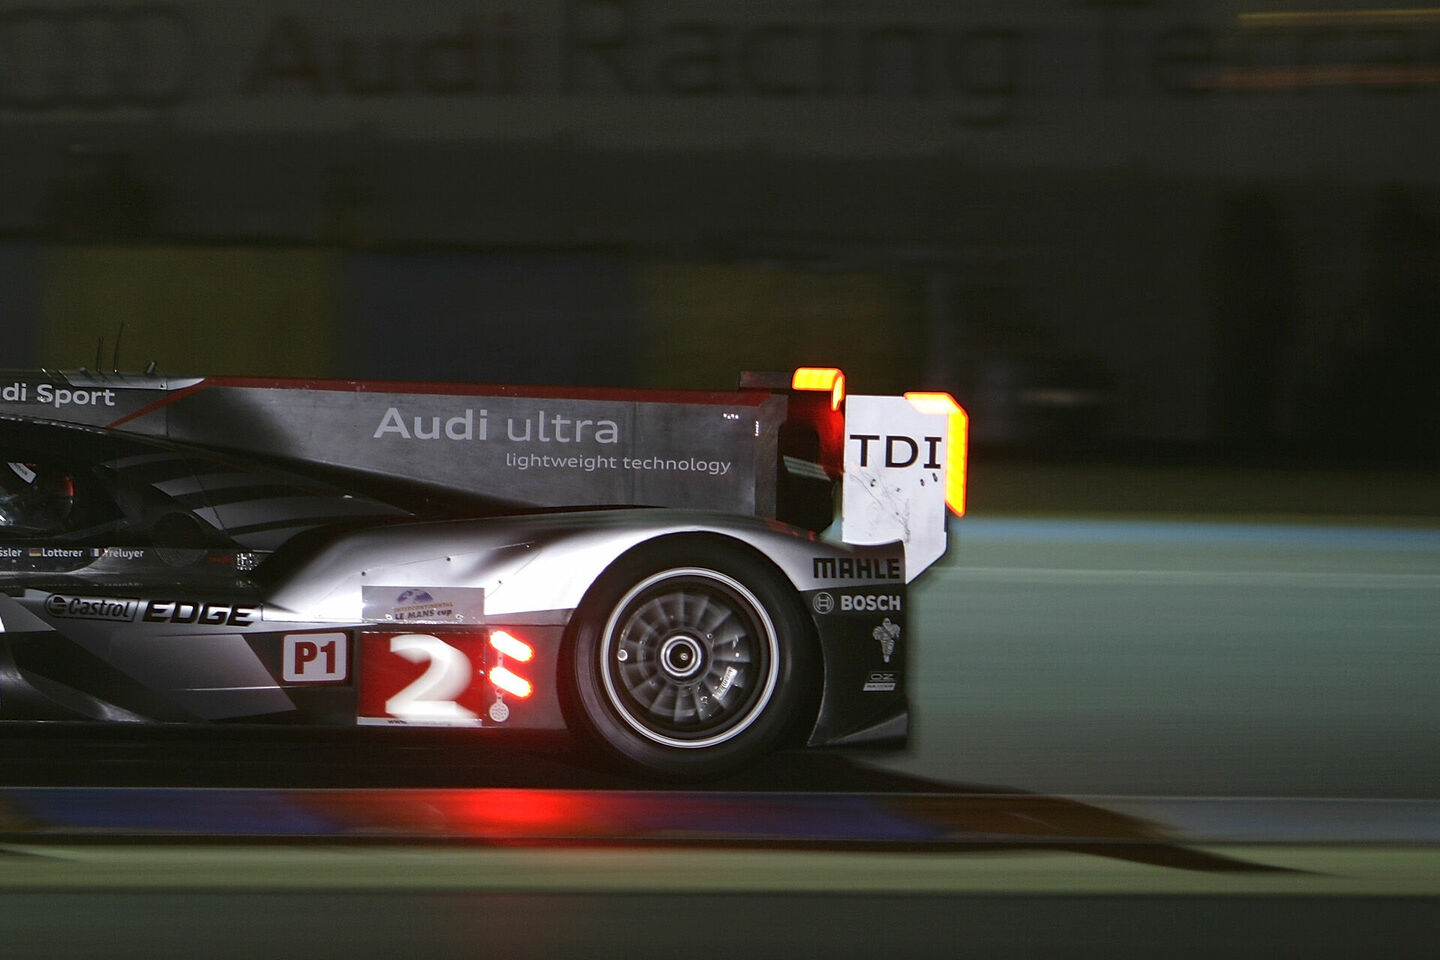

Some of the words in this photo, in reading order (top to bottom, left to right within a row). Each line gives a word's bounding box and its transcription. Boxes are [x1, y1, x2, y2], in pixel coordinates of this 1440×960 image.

[242, 14, 514, 100] Audi
[37, 384, 115, 408] Sport
[373, 407, 487, 440] Audi
[507, 411, 618, 443] ultra
[506, 453, 617, 472] lightweight
[622, 455, 731, 474] technology
[850, 434, 942, 469] TDI
[42, 547, 84, 557] Lotterer
[813, 558, 900, 579] MAHLE
[69, 598, 131, 618] Castrol
[142, 600, 260, 627] EDGE
[395, 612, 405, 620] LE
[407, 609, 435, 619] MANS
[841, 596, 901, 611] BOSCH
[295, 641, 336, 675] P1
[385, 633, 474, 720] 2
